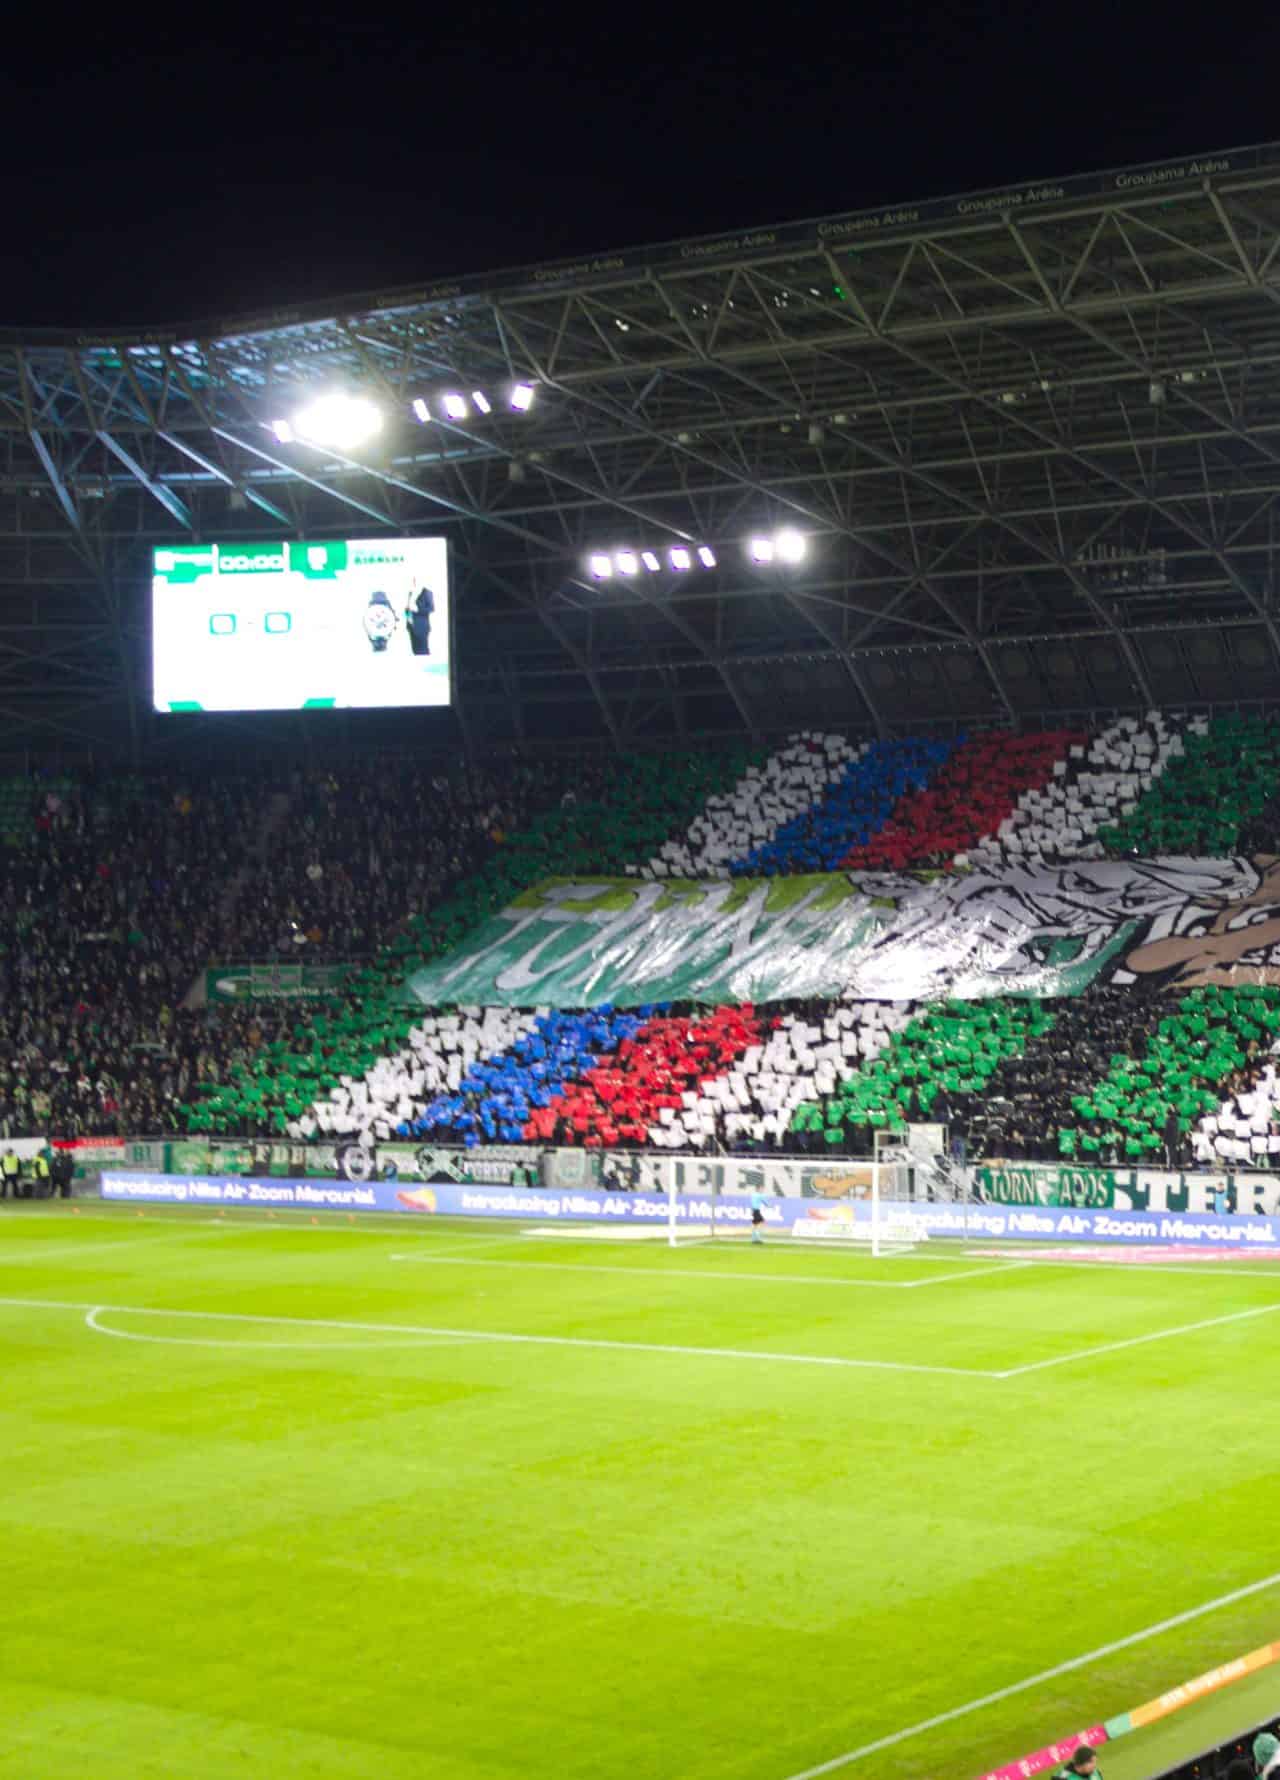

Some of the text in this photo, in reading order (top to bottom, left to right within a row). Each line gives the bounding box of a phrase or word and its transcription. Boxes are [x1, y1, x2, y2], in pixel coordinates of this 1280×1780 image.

[461, 1193, 562, 1216] Introducing
[563, 1197, 602, 1215] Nike
[603, 1199, 631, 1215] Air
[1008, 1213, 1055, 1233] Nike
[1056, 1215, 1090, 1234] Air
[1093, 1217, 1158, 1238] Zoom
